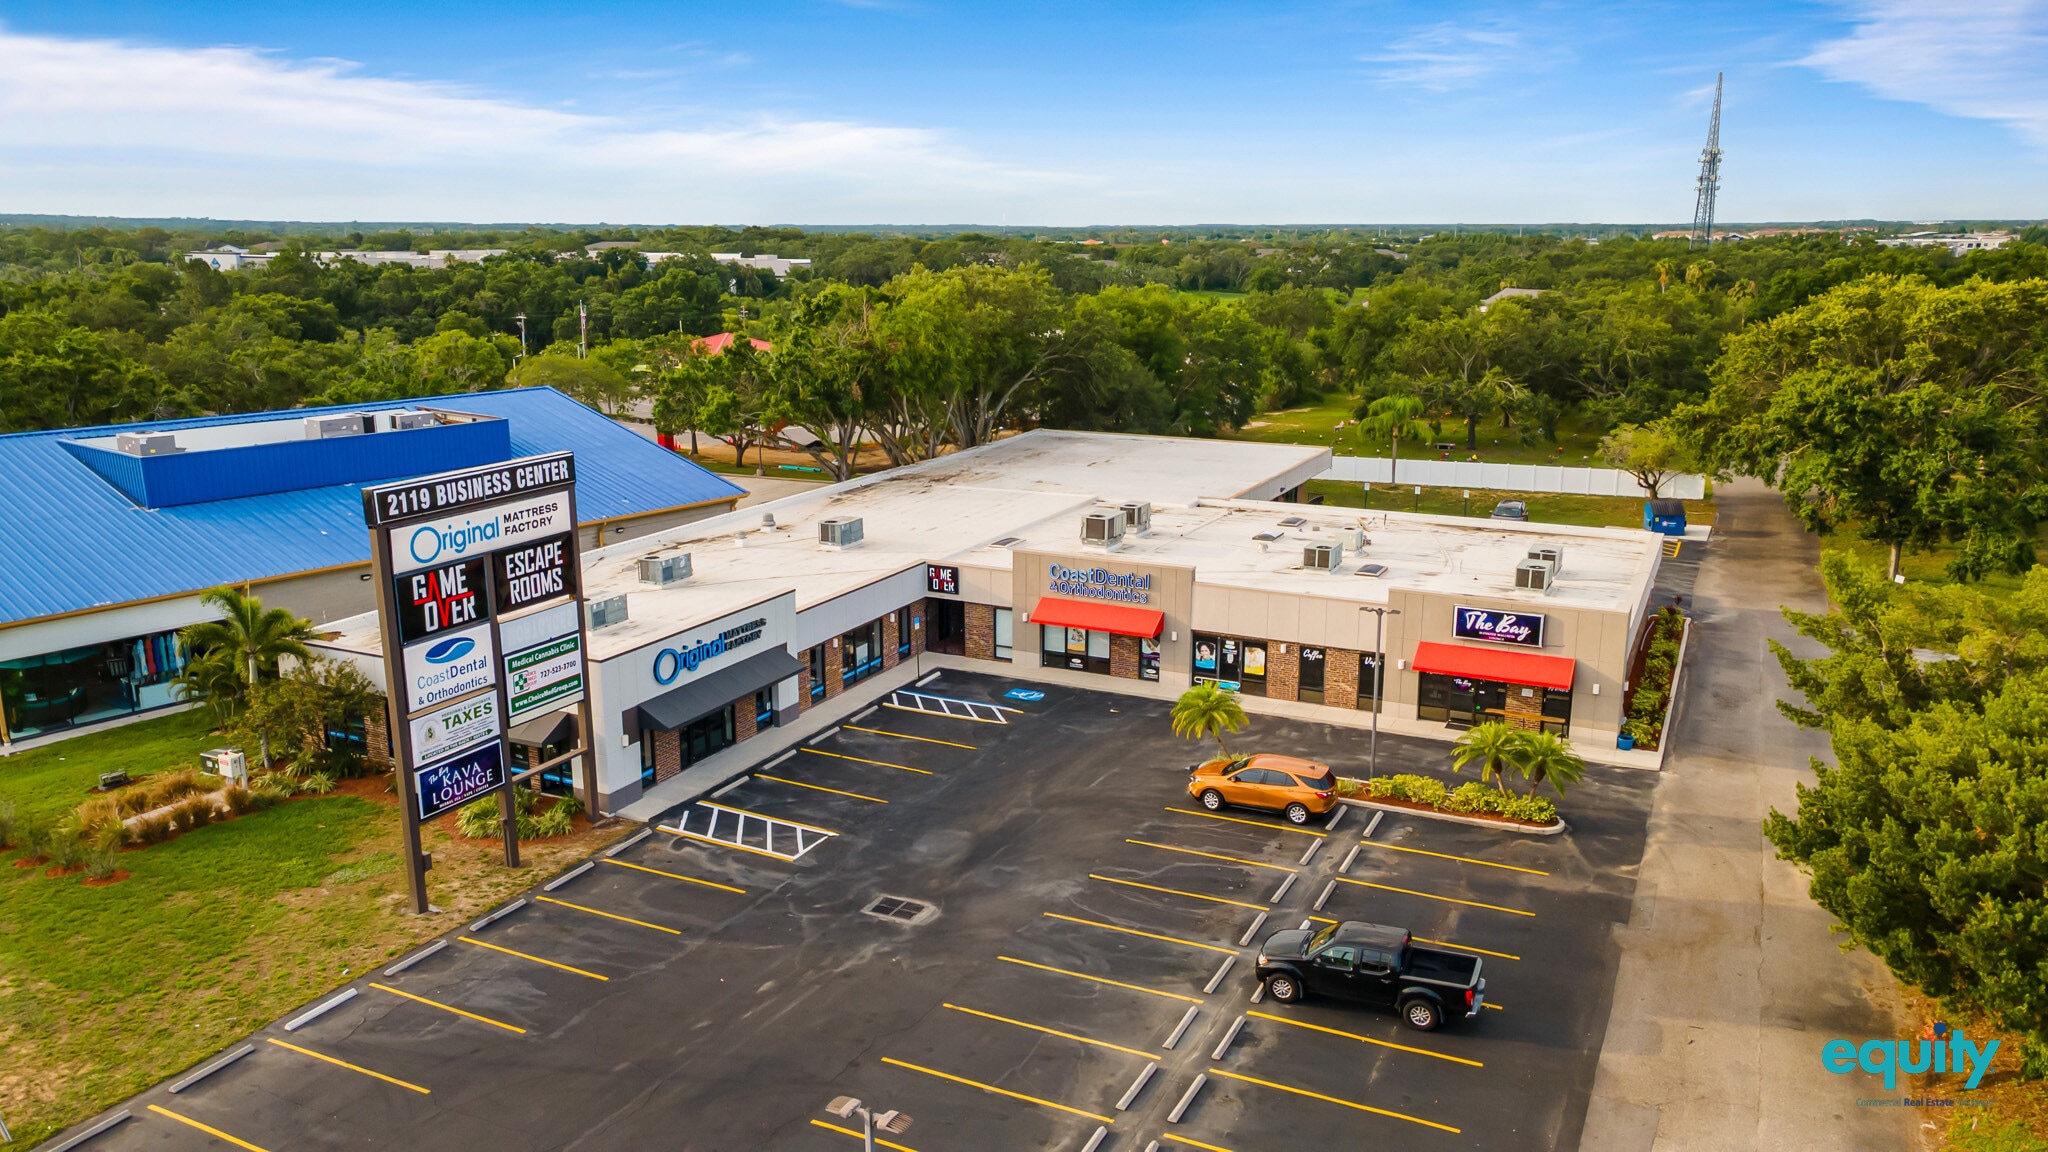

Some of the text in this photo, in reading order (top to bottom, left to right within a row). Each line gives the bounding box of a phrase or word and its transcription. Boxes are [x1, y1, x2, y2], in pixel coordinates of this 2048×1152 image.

[387, 459, 569, 516] 2119 BUSINESS CENTER
[503, 502, 558, 524] MATTRESS
[504, 516, 553, 536] FACTORY
[410, 516, 500, 564] Original
[505, 541, 563, 579] ESCAPE
[929, 567, 952, 580] GAME
[412, 564, 468, 600] GAME
[509, 567, 563, 605] ROOMS
[933, 579, 955, 592] OVER
[1049, 563, 1150, 590] CoastDental
[1049, 581, 1148, 604] & Orthodontics
[424, 595, 477, 633] OVER
[1465, 611, 1531, 641] The Bay
[725, 618, 767, 640] MATTRESS
[725, 630, 762, 651] FACTORY
[511, 641, 575, 669] Medical Cannabis Clinic
[653, 631, 725, 685] Original
[1303, 648, 1323, 661] Coffee
[417, 656, 487, 689] CoastDental
[540, 660, 577, 678] 727-523-3700
[418, 676, 488, 705] & Orthodontics
[442, 702, 493, 730] TAXES
[432, 768, 494, 805] LOUNGE
[442, 761, 482, 787] KAVA
